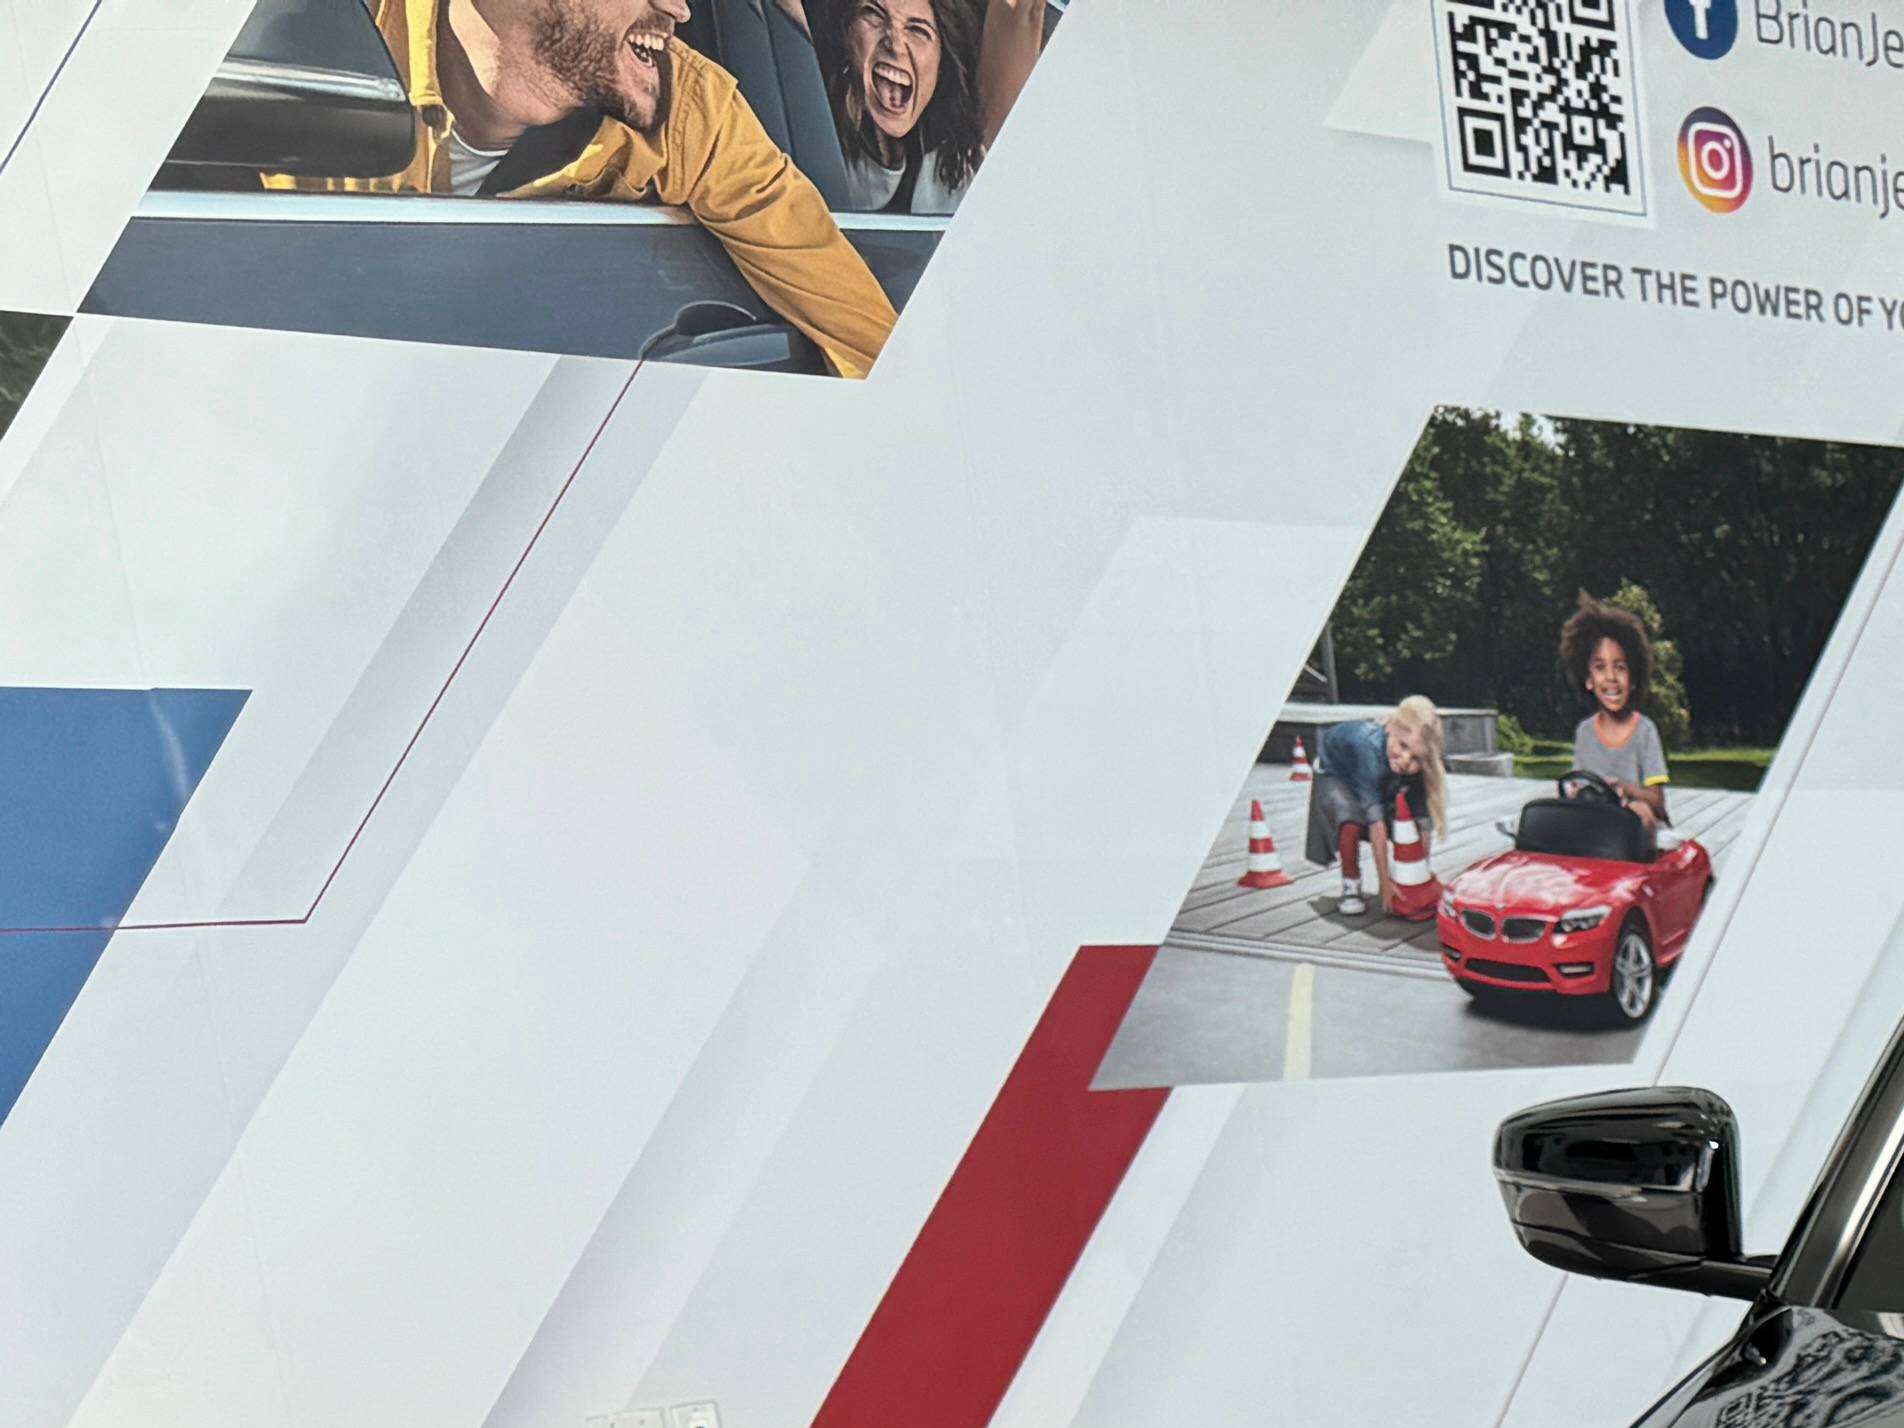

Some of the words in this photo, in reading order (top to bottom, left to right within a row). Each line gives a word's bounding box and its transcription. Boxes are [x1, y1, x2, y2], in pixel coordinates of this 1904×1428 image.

[1448, 243, 1625, 300] DISCOVER
[1631, 267, 1701, 307] THE
[1709, 277, 1826, 324] POWER
[1834, 292, 1873, 328] OF
